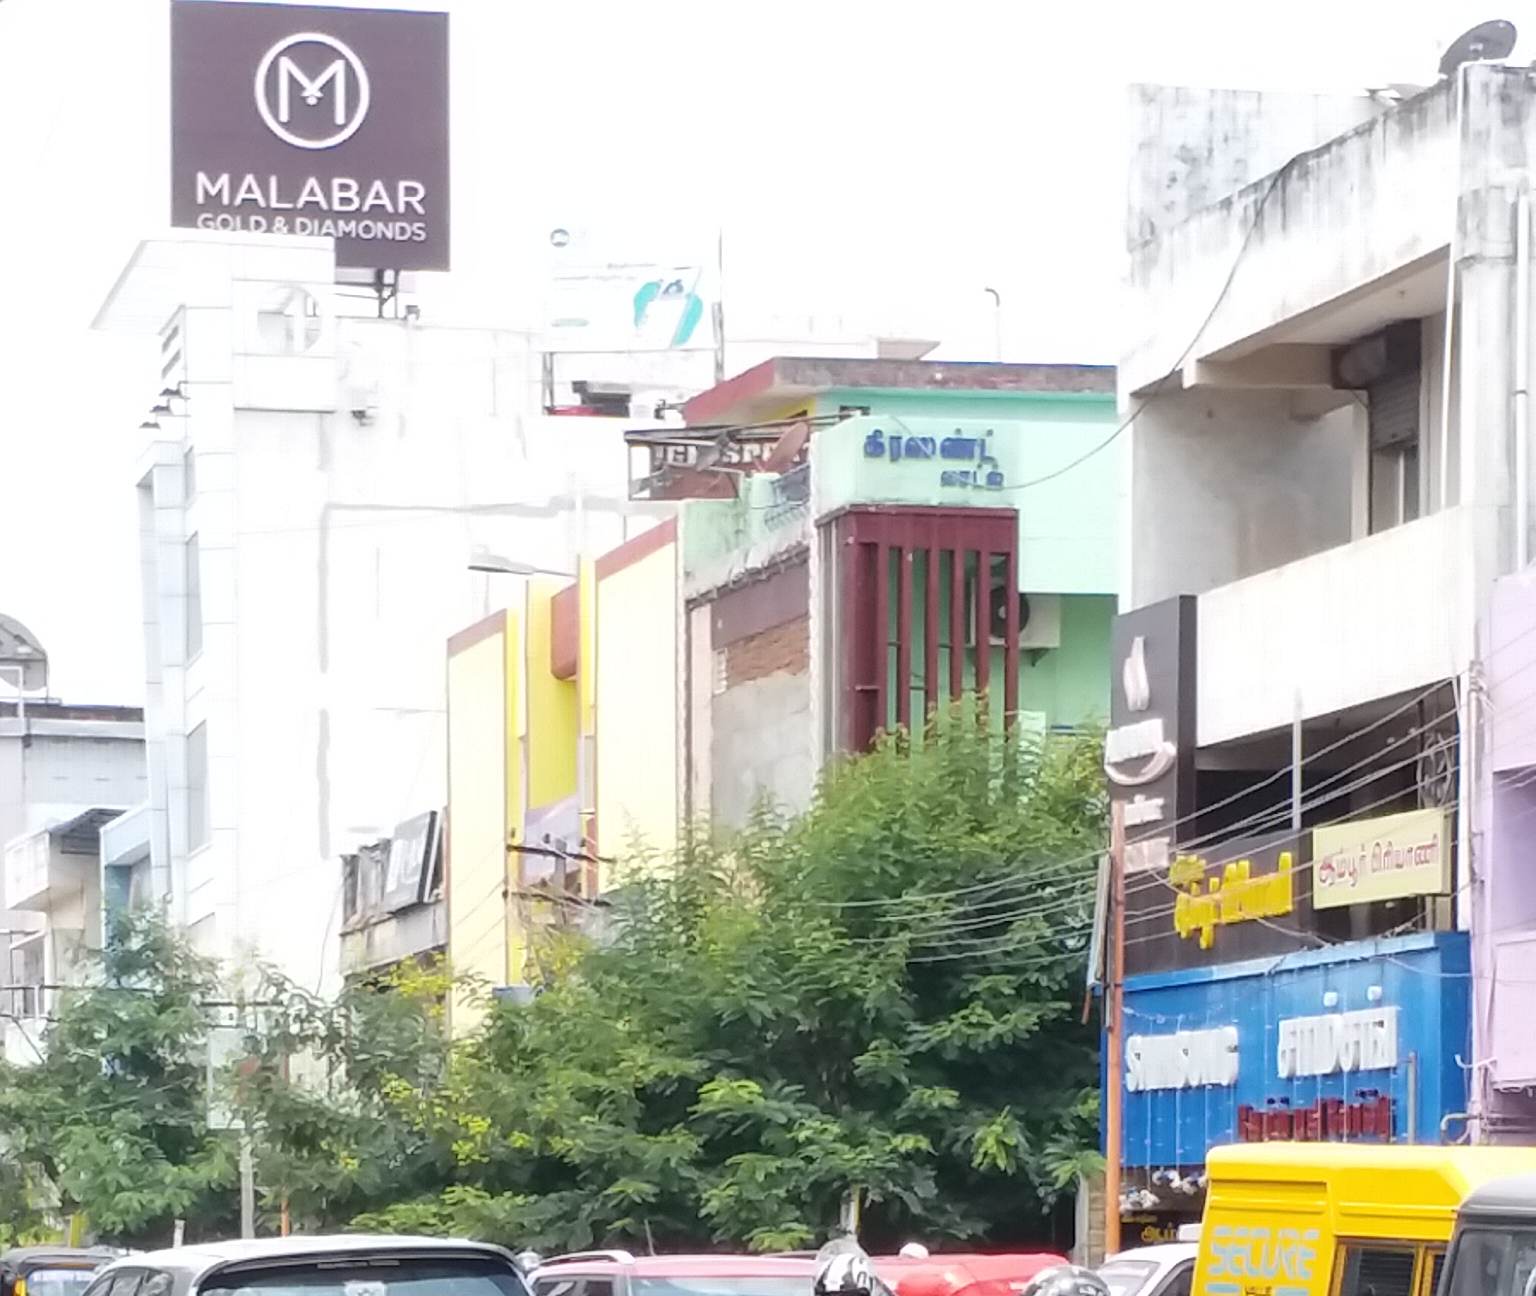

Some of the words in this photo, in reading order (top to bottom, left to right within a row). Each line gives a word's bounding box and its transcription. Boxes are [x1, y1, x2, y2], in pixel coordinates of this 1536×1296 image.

[195, 170, 426, 216] MALABAR
[197, 212, 268, 234] GOLD
[272, 215, 290, 236] &
[295, 217, 427, 242] DIAMONDS
